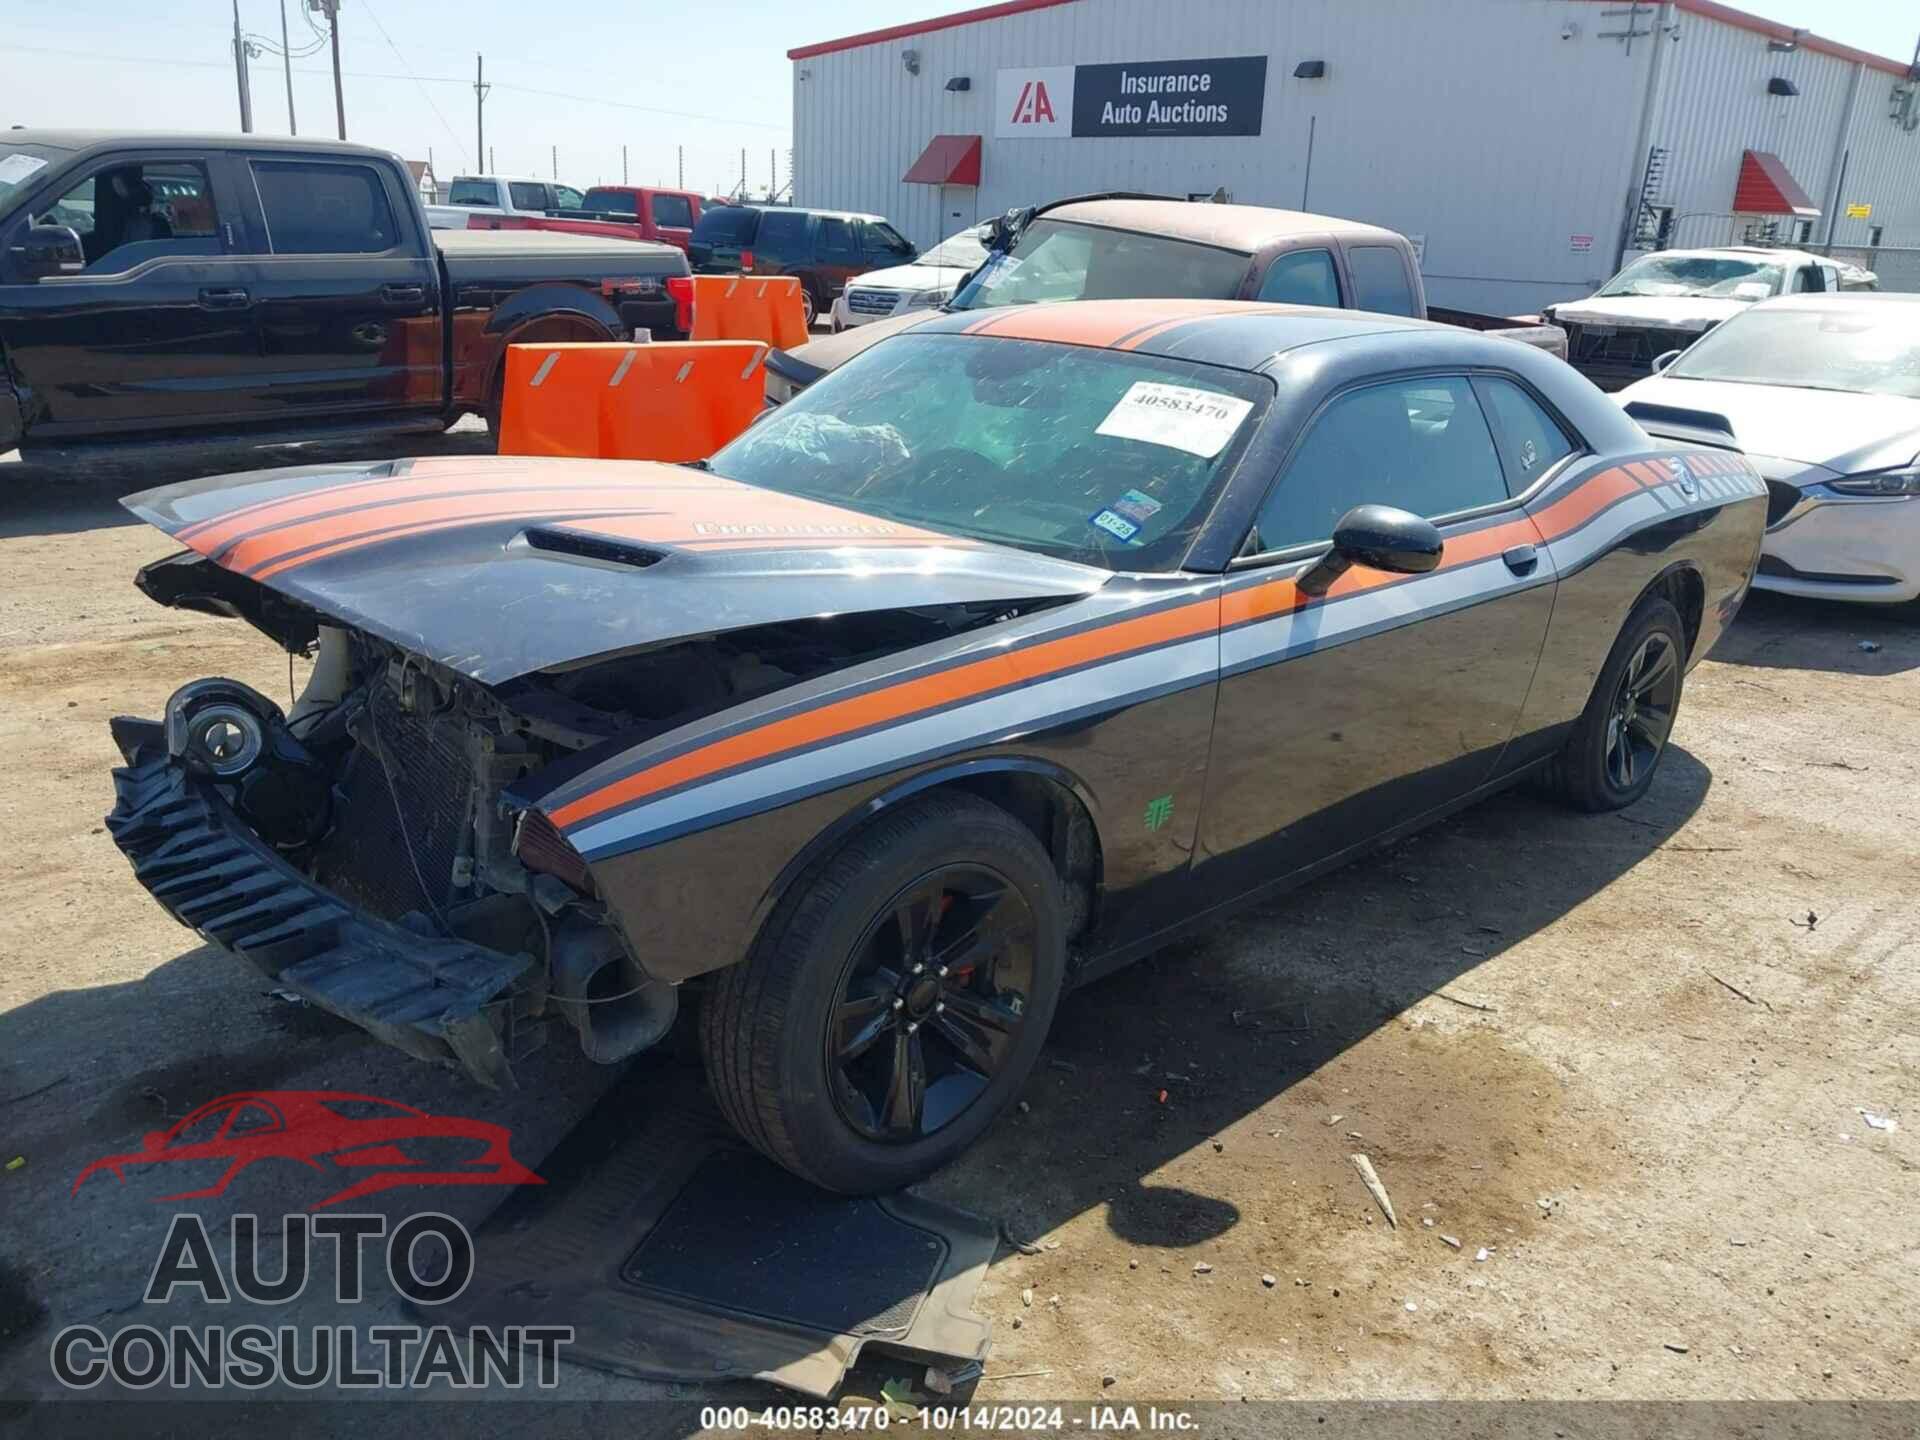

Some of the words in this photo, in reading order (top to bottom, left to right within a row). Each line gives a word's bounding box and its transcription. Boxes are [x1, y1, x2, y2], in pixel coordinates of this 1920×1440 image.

[1120, 70, 1212, 94] Insurance
[1100, 101, 1142, 124] Auto
[1146, 99, 1229, 124] Auctions
[1132, 393, 1229, 420] 40583470
